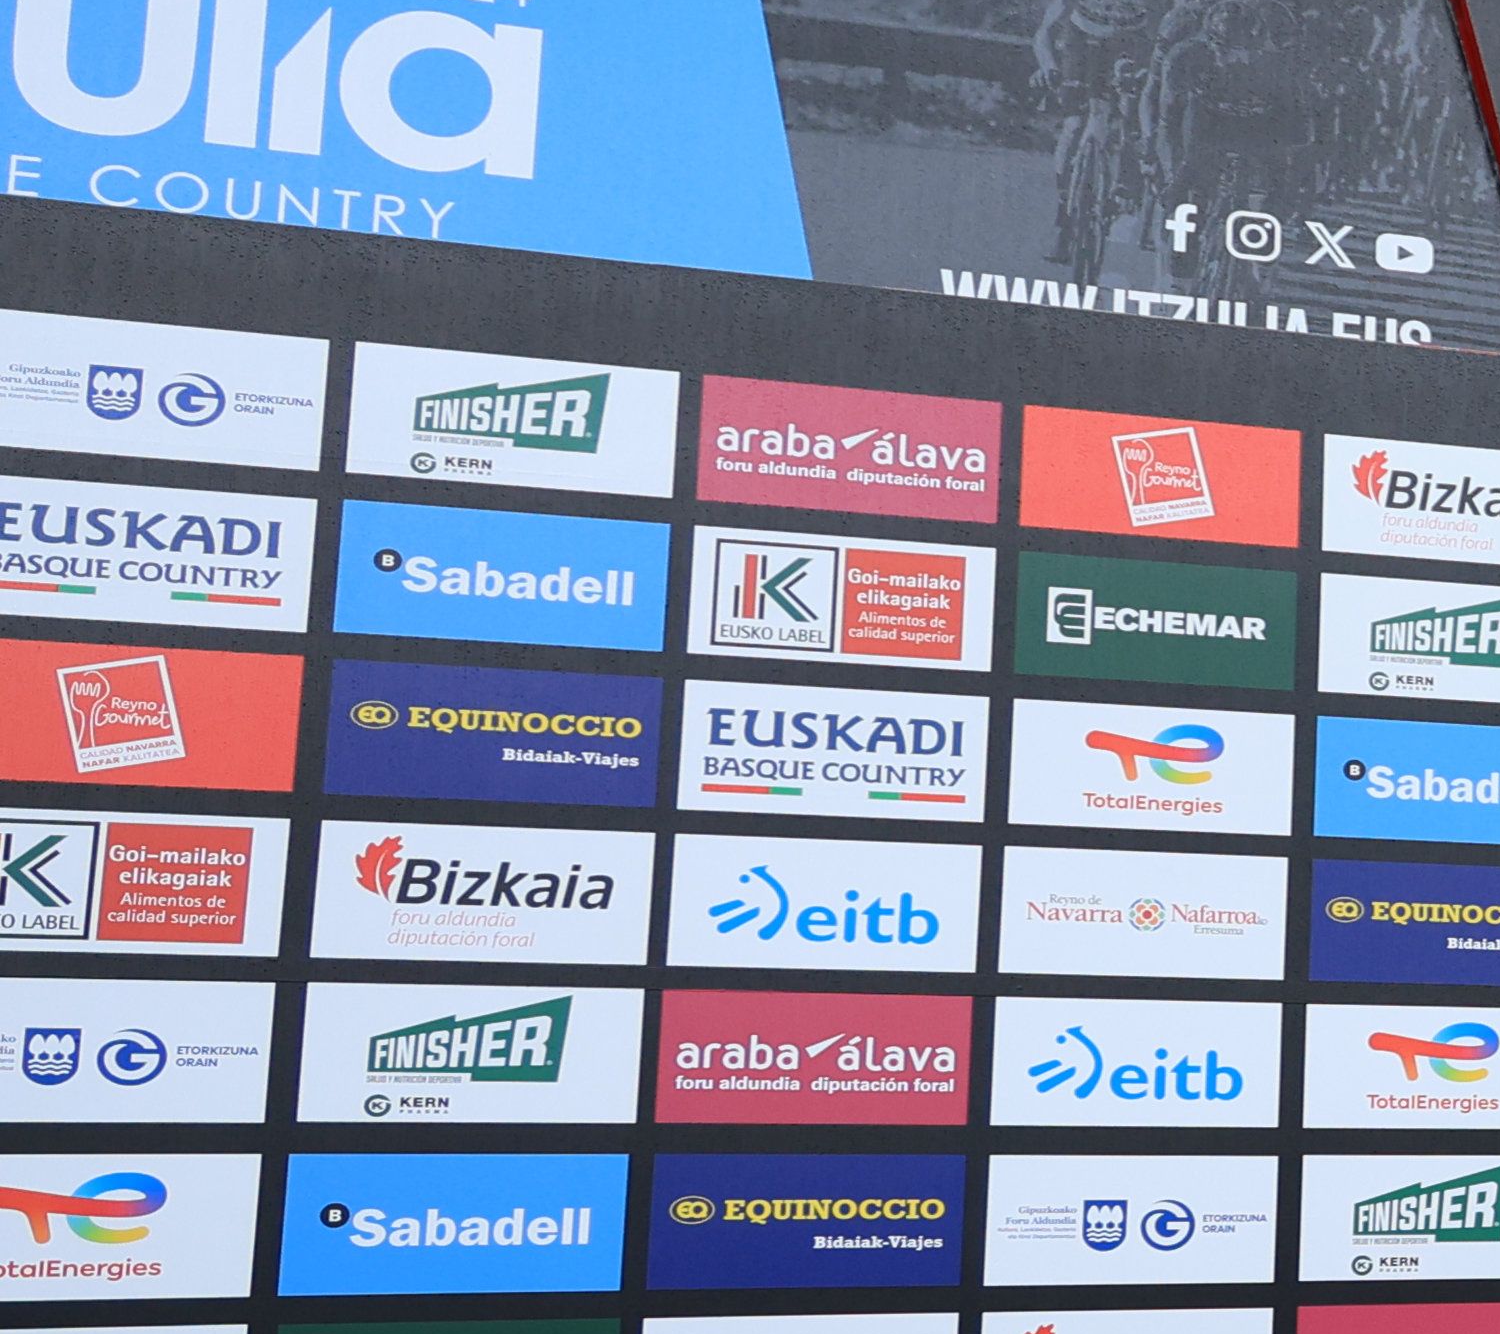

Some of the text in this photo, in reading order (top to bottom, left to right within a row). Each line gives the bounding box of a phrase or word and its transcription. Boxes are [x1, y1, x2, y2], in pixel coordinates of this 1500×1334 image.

[90, 163, 457, 239] COUNTRY
[233, 403, 276, 416] ORAIN
[234, 392, 314, 409] ETORKIZUNA
[420, 388, 589, 438] FINISHER
[444, 455, 493, 470] KERN
[717, 423, 987, 473] araba álava
[716, 457, 986, 493] foru aldundia diputación foral
[0, 502, 282, 559] EUSKADI
[0, 552, 283, 590] ASQUE COUNTRY
[402, 555, 633, 606] Sabadell
[847, 568, 961, 593] Goi-mailako
[856, 589, 951, 615] elikagaiak
[720, 624, 826, 644] EUSKO LABEL
[847, 625, 955, 646] calidad superior
[858, 610, 946, 629] Alimentos de
[1094, 607, 1266, 641] ECHEMAR
[95, 702, 171, 731] Gourmet
[111, 696, 158, 713] Reyno
[407, 706, 642, 739] EQUINOCCIO
[707, 707, 964, 758] EUSKADI
[502, 747, 640, 769] Bidaiak-Viajes
[703, 756, 966, 788] BASQUE COUNTRY
[1082, 792, 1223, 817] TotalEnergies
[398, 857, 613, 910] Bizkaia
[795, 889, 939, 946] eitb
[1026, 900, 1123, 924] Navarra
[375, 1015, 553, 1069] FINISHER
[1367, 1094, 1499, 1113] TotalEnergies
[350, 1208, 590, 1248] Sabadell
